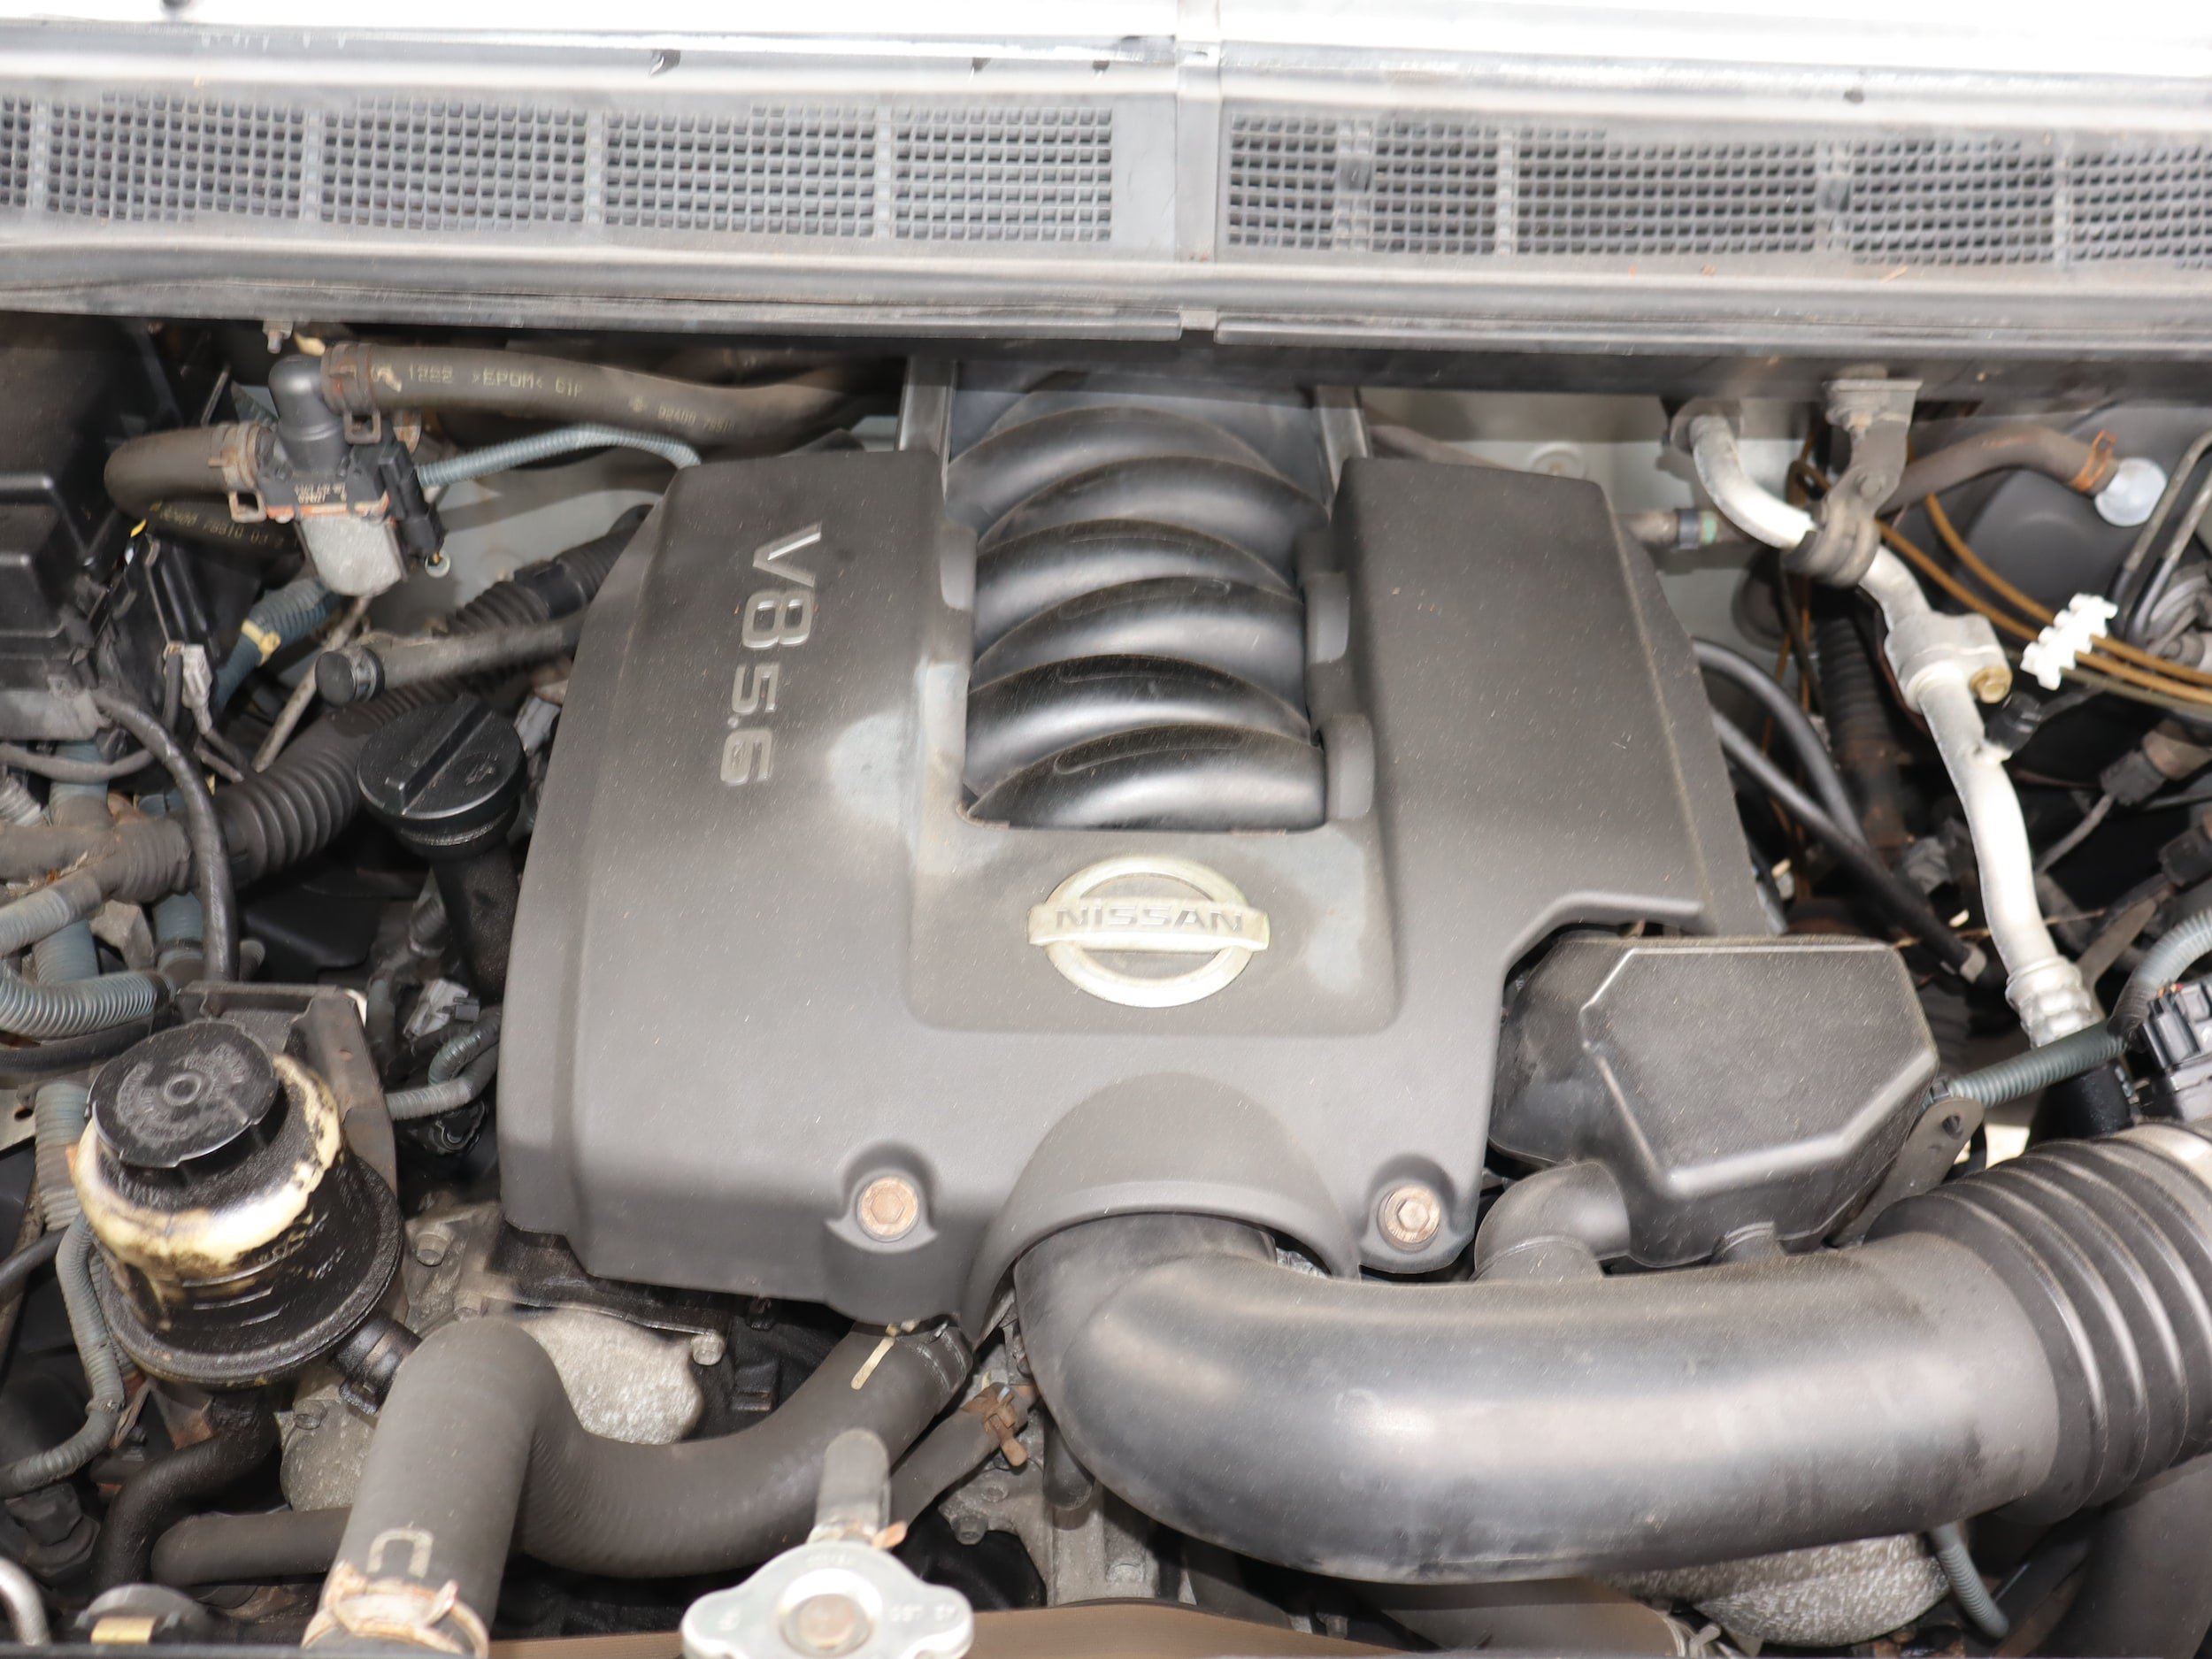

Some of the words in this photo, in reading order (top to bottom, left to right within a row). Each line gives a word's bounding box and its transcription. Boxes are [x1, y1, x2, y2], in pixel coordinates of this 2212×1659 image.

[741, 519, 822, 649] V8
[719, 661, 780, 787] 5.6
[1054, 903, 1244, 934] NISSAN
